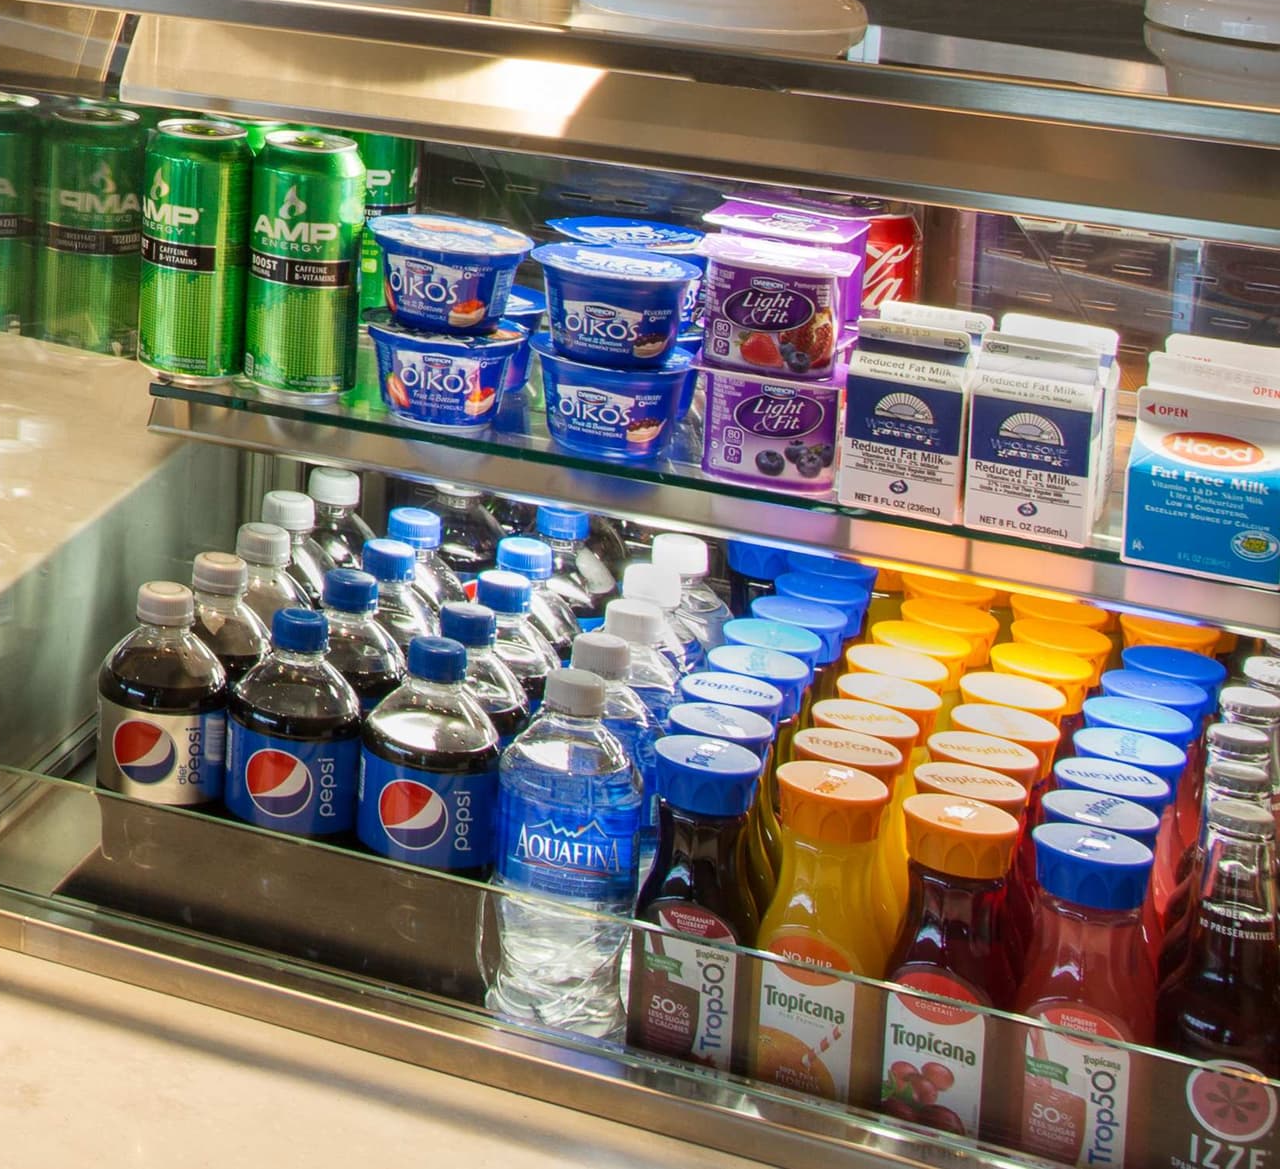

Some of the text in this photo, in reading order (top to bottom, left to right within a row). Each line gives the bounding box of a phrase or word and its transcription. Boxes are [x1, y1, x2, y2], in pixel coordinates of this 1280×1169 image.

[254, 213, 337, 244] AMP
[159, 244, 188, 257] CAFFEINE
[261, 237, 323, 254] ENERGY
[159, 253, 198, 266] B-VITAMINS
[252, 253, 278, 272] BOOST
[294, 264, 328, 275] CAFFEINE
[294, 272, 336, 282] B-VITAMINS
[742, 292, 794, 312] Light
[565, 314, 640, 341] OIKOS
[716, 322, 729, 331] 80
[859, 355, 952, 378] Reduced Fat Milk
[400, 367, 475, 395] OIKOS
[981, 374, 1078, 396] Reduced Fat Milk
[559, 398, 631, 426] OIKOS
[753, 399, 804, 419] Light
[1158, 406, 1189, 419] OPEN
[727, 430, 740, 439] 80
[851, 439, 944, 466] Reduced Fat Milk
[1173, 435, 1252, 463] Hood
[975, 462, 1072, 487] Reduced Fat Milk
[1151, 465, 1270, 496] Fat Free Milk
[854, 492, 941, 517] NET 8 FL OZ (236mL)
[979, 515, 1068, 539] NET 8 FL OZ (236mL)
[692, 678, 776, 701] Tropicana
[187, 725, 204, 787] pepsi
[807, 735, 896, 758] Tropicana
[176, 763, 188, 787] diet
[925, 772, 1016, 789] Tropicana
[1065, 769, 1158, 785] Tropicana
[318, 755, 337, 819] pepsi
[453, 789, 473, 852] pepsi
[514, 822, 622, 874] AQUAFINA
[670, 909, 716, 926] POMEGRANATE
[676, 918, 708, 931] BLUEBERRY
[650, 994, 690, 1019] 50%
[763, 984, 845, 1026] Tropicana
[915, 1001, 953, 1017] COCKTAIL
[1060, 1013, 1097, 1029] RASPBERRY
[890, 1023, 976, 1066] Tropicana
[1083, 1054, 1121, 1072] Tropicana
[1031, 1102, 1076, 1129] 50%
[1088, 1069, 1119, 1165] Trop50
